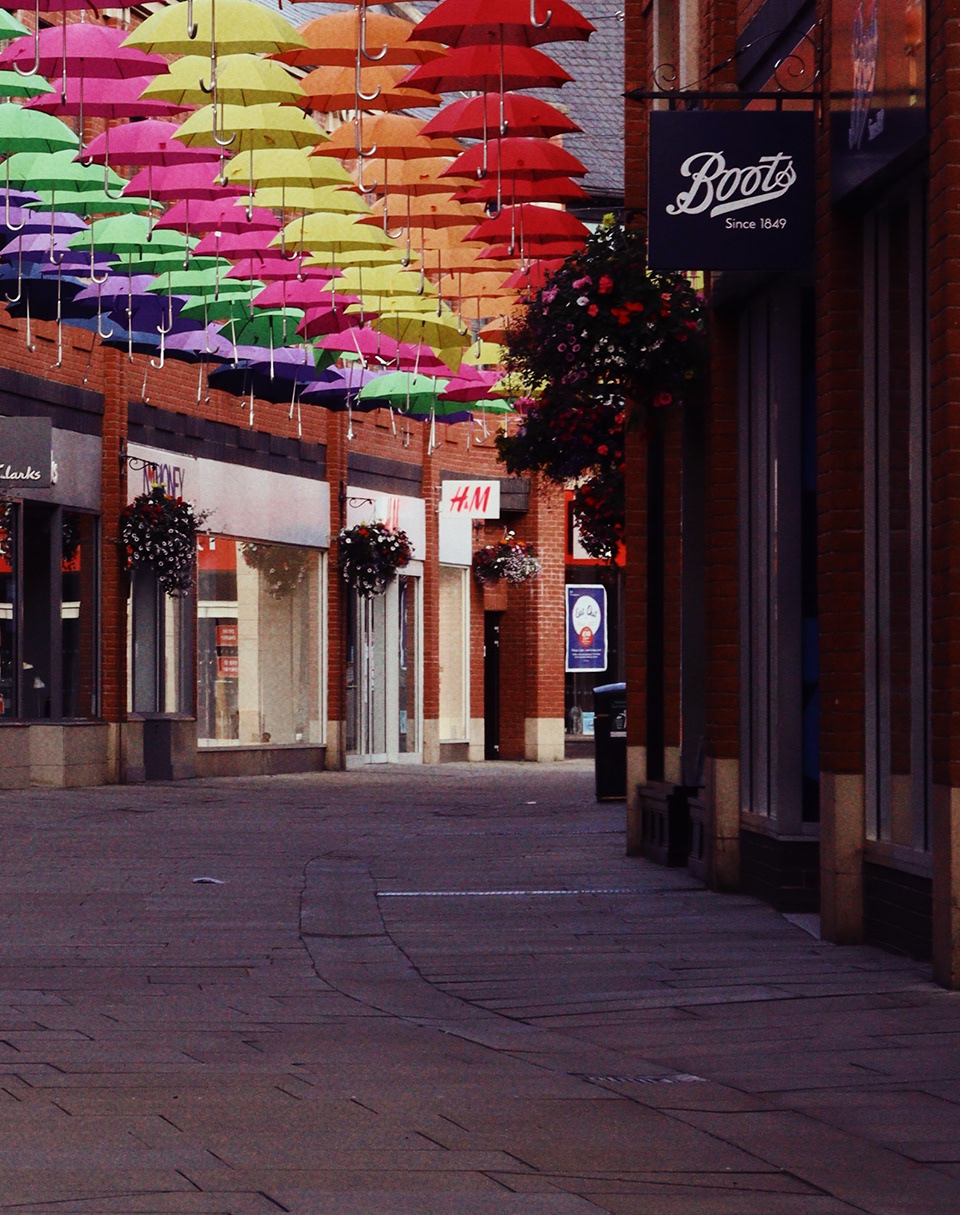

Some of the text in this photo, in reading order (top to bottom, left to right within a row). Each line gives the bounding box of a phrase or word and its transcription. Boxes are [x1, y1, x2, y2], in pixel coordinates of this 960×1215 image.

[665, 151, 797, 218] Boots
[725, 217, 787, 229] Since 1849
[450, 485, 491, 513] H&M
